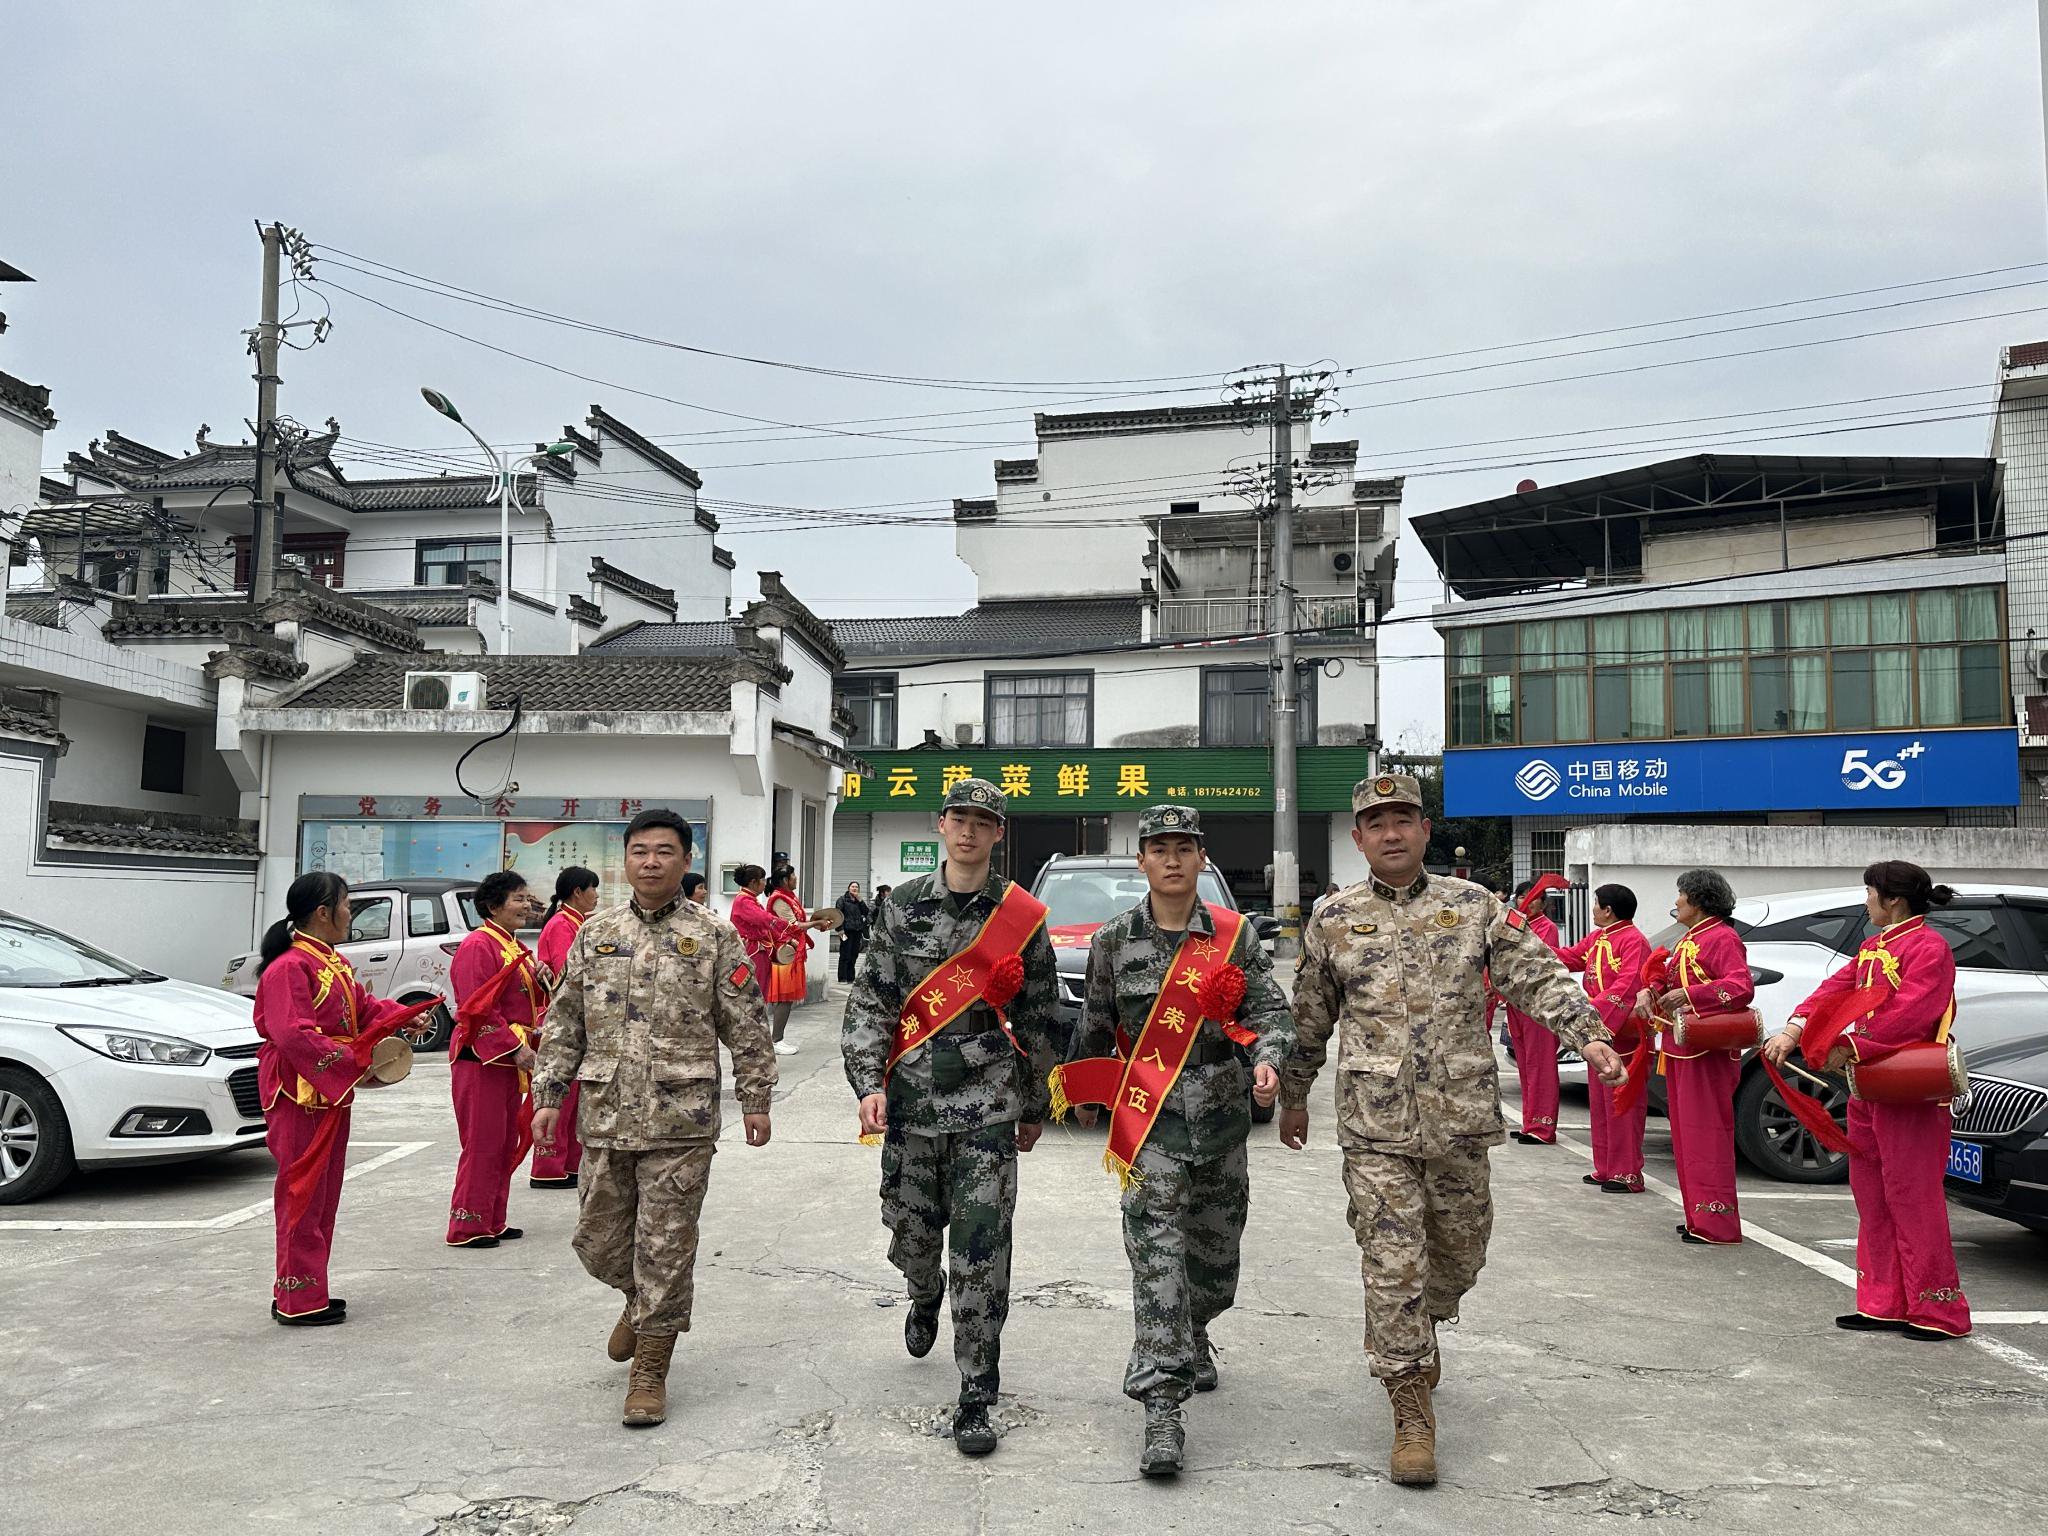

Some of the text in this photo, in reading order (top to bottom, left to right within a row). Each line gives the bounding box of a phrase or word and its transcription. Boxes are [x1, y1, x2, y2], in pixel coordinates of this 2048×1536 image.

[1568, 758, 1668, 781] 中国移动
[1194, 787, 1261, 797] 18175424762
[1568, 782, 1668, 798] China Mobile
[358, 796, 643, 817] 党务公开栏
[900, 988, 947, 1040] 光荣
[1128, 966, 1203, 1114] 光荣入伍
